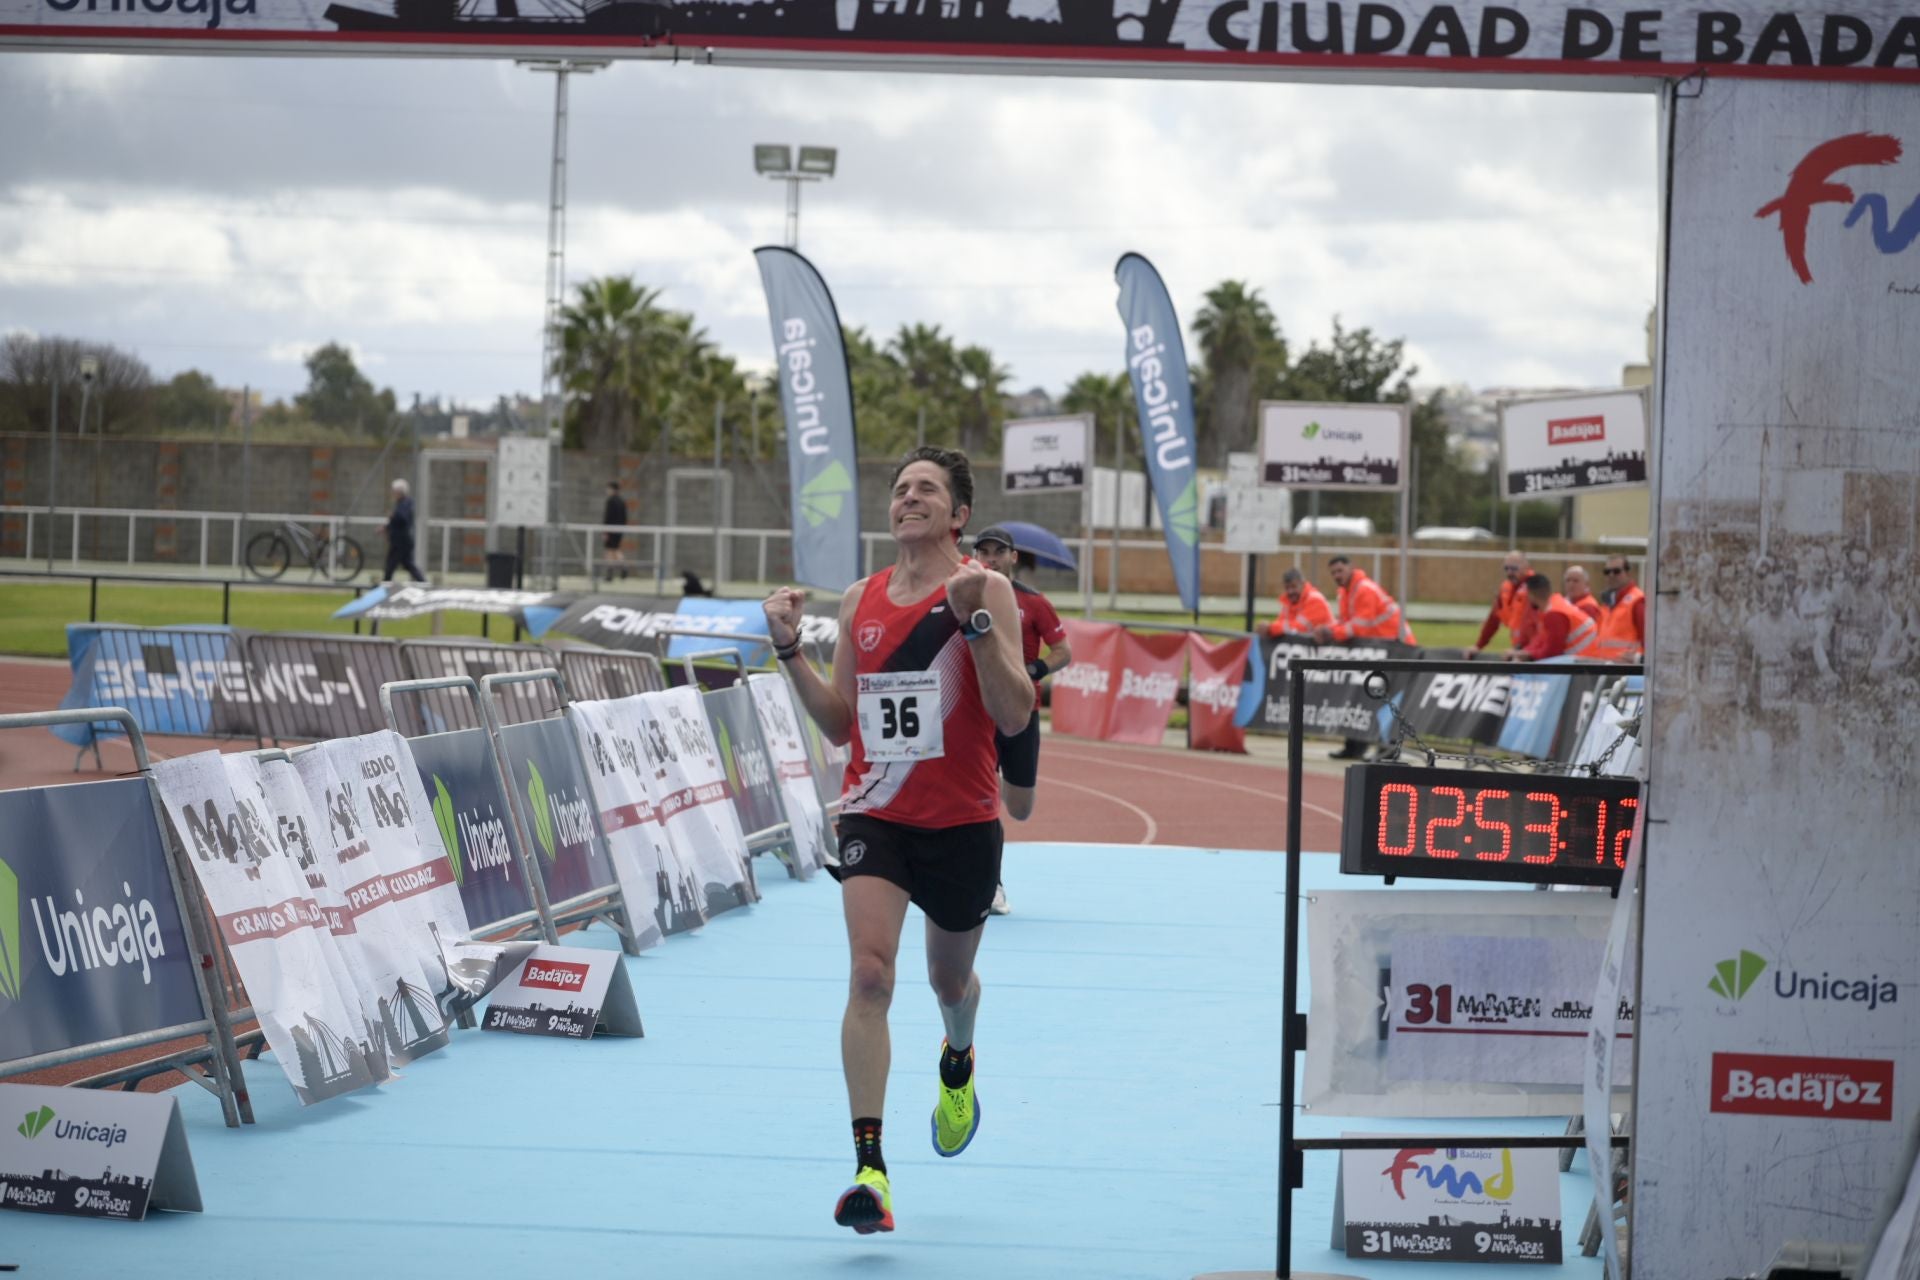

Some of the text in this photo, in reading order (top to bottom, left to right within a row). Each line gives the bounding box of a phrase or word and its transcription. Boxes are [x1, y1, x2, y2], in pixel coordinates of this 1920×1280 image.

[1207, 0, 1530, 57] CIUDAD
[1561, 8, 1662, 62] DE
[1321, 429, 1363, 443] Unicaja
[880, 697, 920, 739] 36
[549, 786, 596, 857] Unicaja
[457, 803, 512, 882] Unicaja
[31, 881, 166, 985] Unicaja
[528, 966, 583, 987] Badajoz
[1775, 970, 1898, 1011] Unicaja
[490, 1011, 508, 1028] 31
[1405, 983, 1452, 1025] 31
[547, 1015, 559, 1031] 9
[1722, 1069, 1883, 1111] Badajoz
[54, 1120, 128, 1148] Unicaja
[75, 1186, 90, 1208] 9
[1362, 1230, 1391, 1253] 31
[1475, 1231, 1492, 1254] 9
